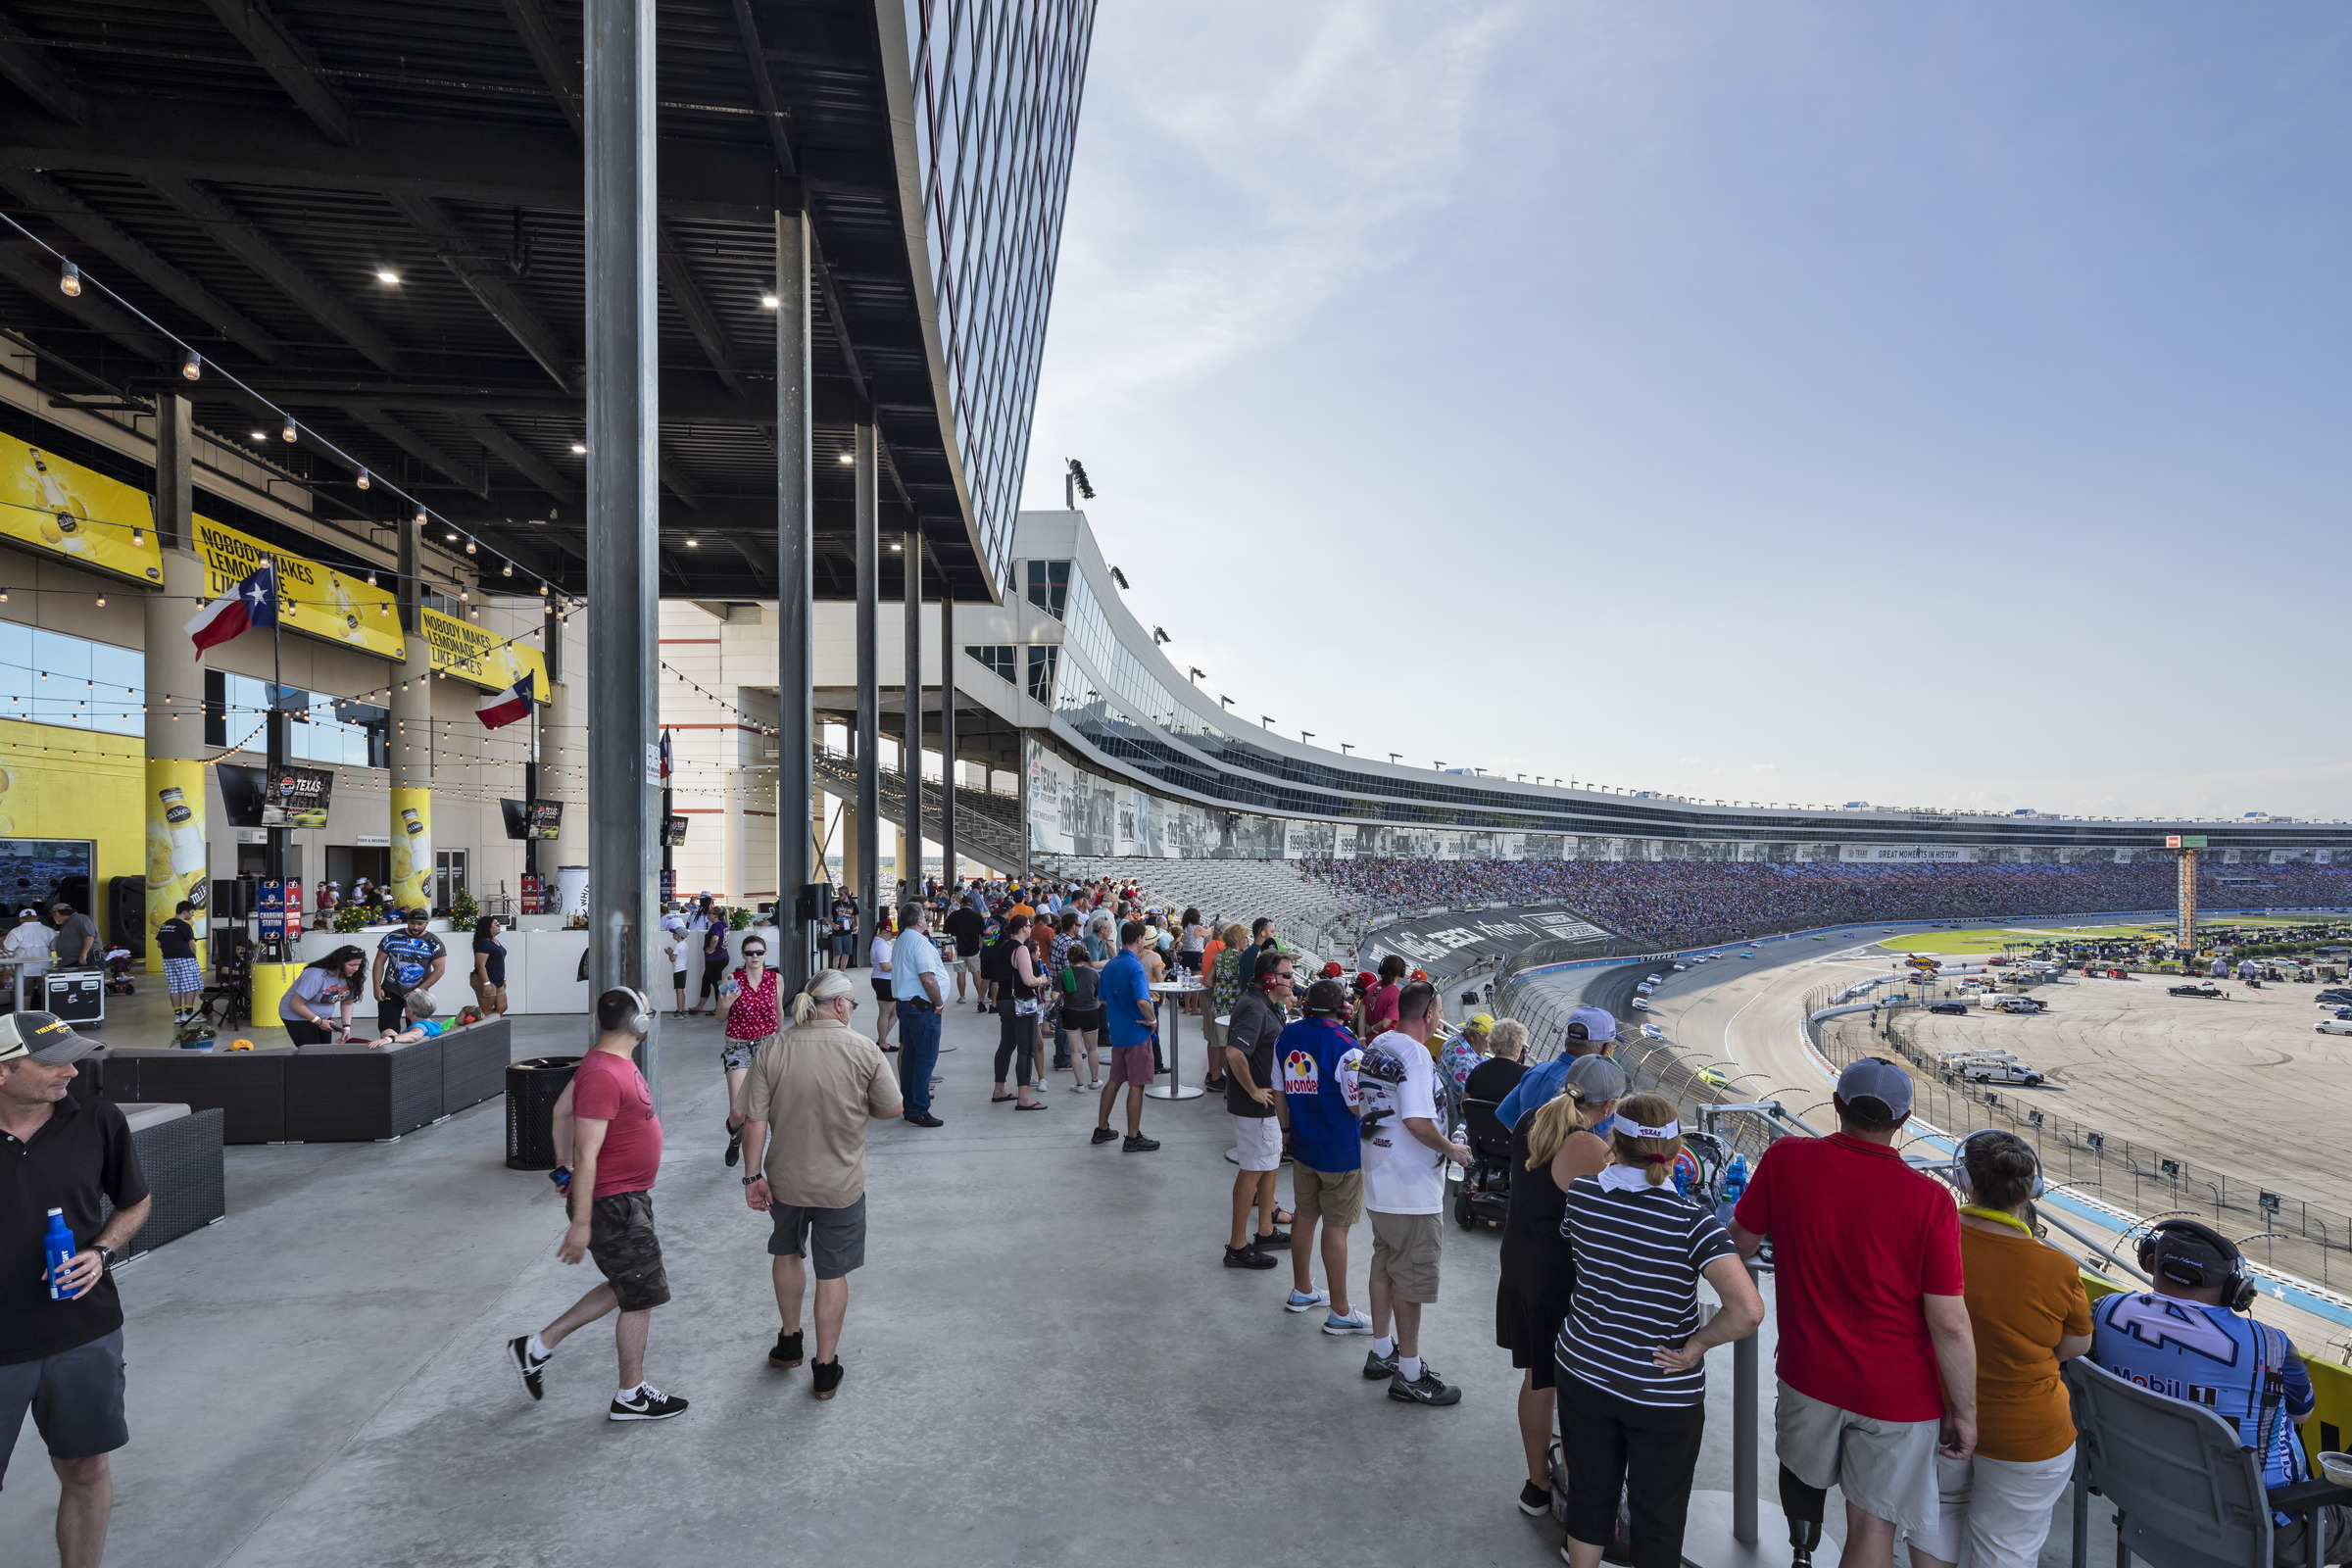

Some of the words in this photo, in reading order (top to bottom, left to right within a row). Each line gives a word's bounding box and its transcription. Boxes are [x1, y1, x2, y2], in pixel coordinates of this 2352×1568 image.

[200, 524, 263, 564] NOBODY
[423, 612, 461, 639] NOBODY
[462, 627, 492, 651] MAKES
[427, 629, 478, 660] LEMONADE
[431, 647, 452, 666] LIKE
[296, 778, 321, 792] TEXAS
[1041, 765, 1057, 795] TEXAS
[1341, 838, 1357, 852] 1999
[1879, 850, 1897, 858] GREAT
[1898, 850, 1928, 859] MOMENTS
[1936, 851, 1959, 859] HISTORY
[2112, 1364, 2181, 1400] Mobil
